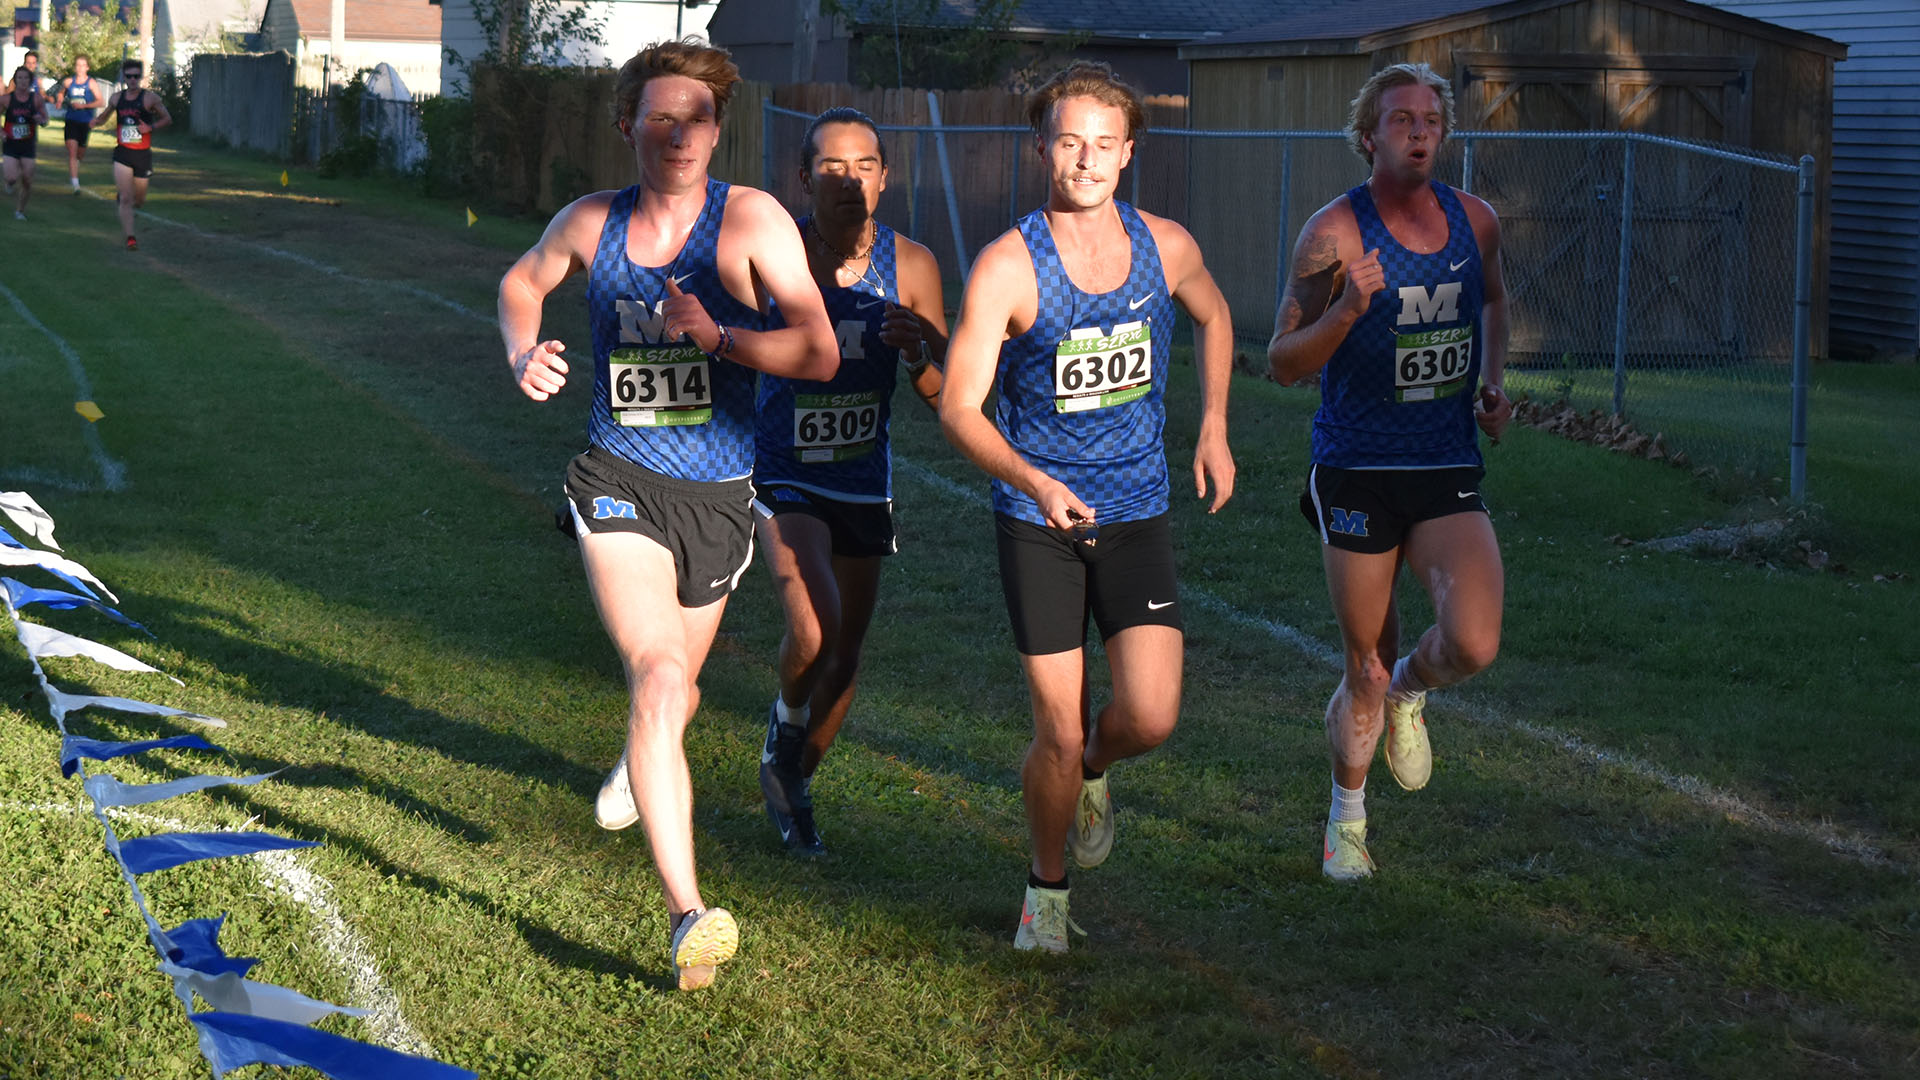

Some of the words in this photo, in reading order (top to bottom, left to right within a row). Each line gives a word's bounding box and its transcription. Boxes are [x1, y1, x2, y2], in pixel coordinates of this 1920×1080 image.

[1397, 281, 1462, 326] M
[1061, 347, 1146, 391] 6302
[1400, 341, 1470, 382] 6303
[616, 365, 706, 403] 6314
[798, 407, 875, 443] 6309
[593, 495, 638, 520] M
[1329, 506, 1369, 537] M
